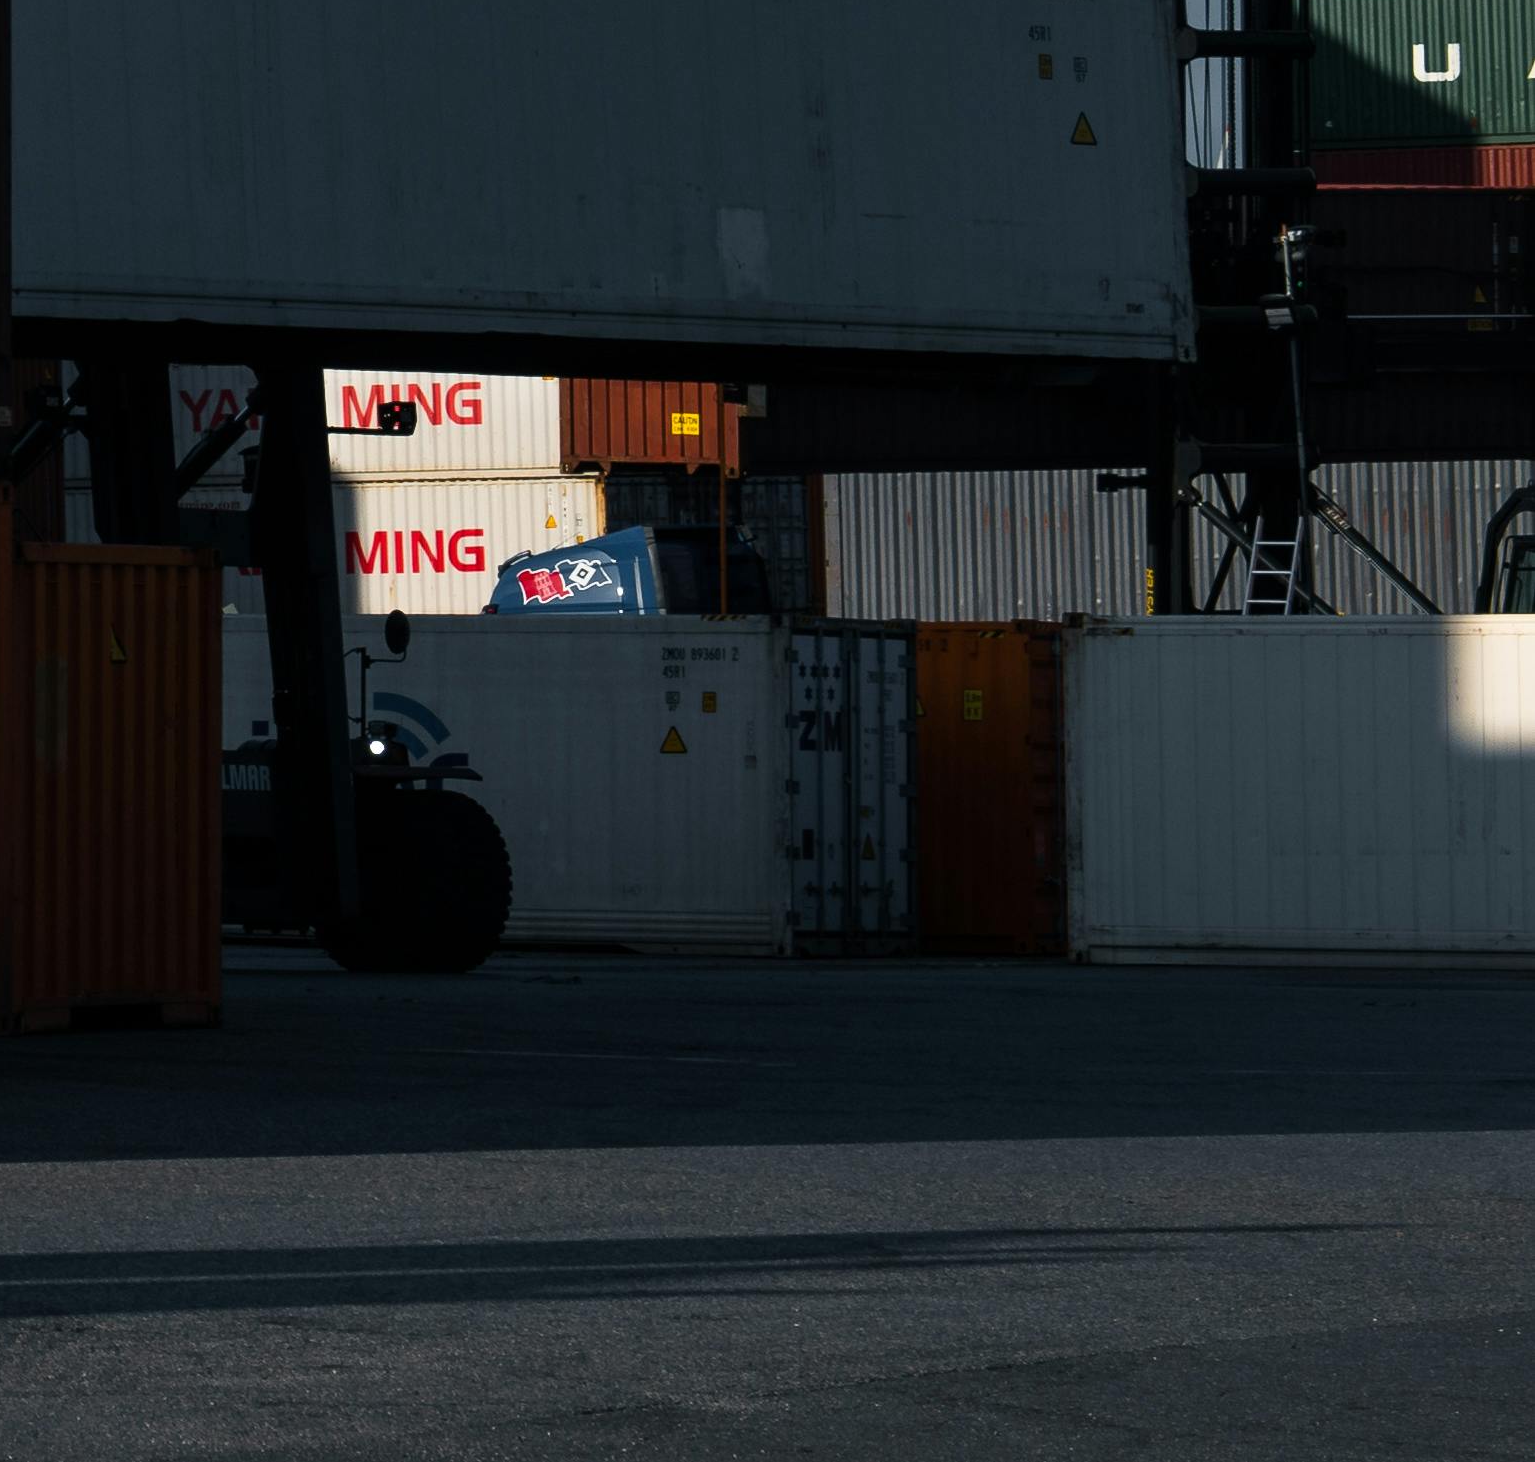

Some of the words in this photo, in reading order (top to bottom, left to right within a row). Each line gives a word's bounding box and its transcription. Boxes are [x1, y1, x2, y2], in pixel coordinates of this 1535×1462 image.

[1029, 25, 1051, 42] 45R1
[180, 389, 261, 433] YA
[342, 382, 483, 431] MING
[344, 529, 485, 574] MING
[662, 666, 685, 678] 45R1
[800, 711, 842, 751] ZM
[221, 764, 272, 793] LMAR
